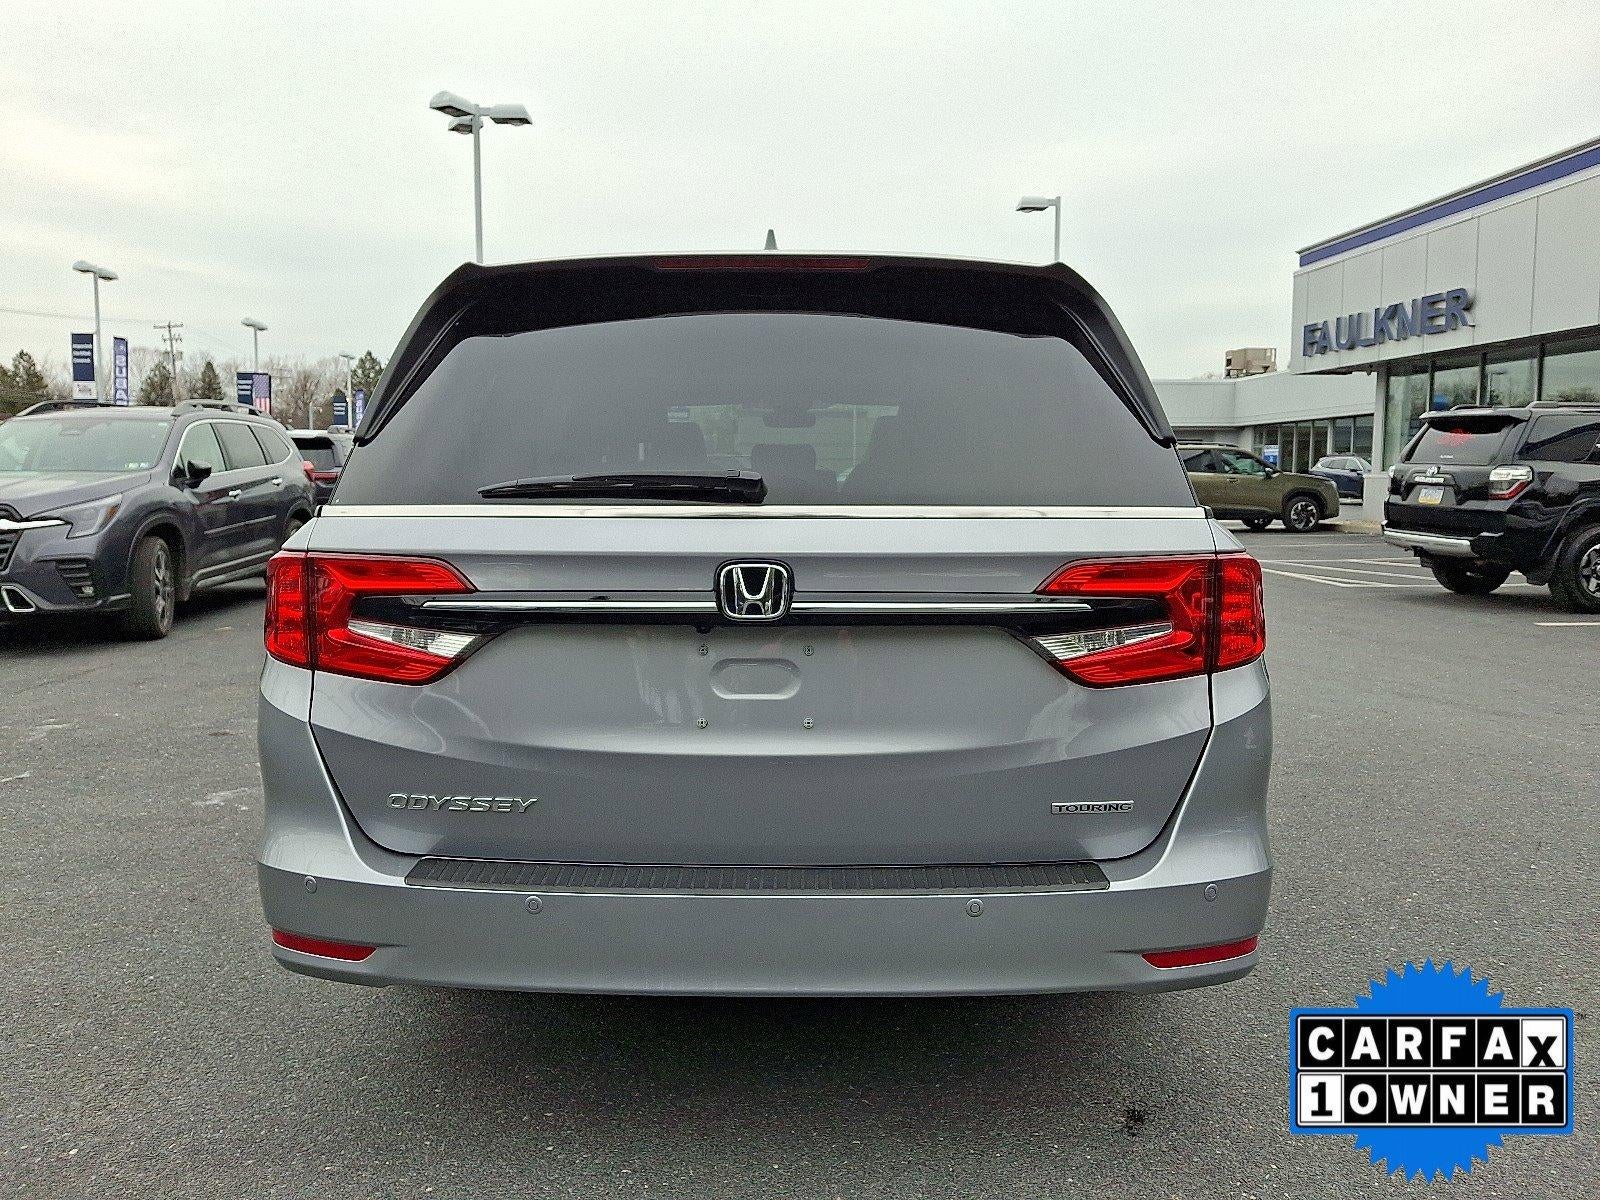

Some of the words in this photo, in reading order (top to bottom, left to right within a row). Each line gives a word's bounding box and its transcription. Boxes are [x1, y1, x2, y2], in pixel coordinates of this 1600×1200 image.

[1302, 288, 1475, 357] FAULKNER
[387, 793, 538, 813] ODYSSEY
[1053, 802, 1133, 813] TOURING
